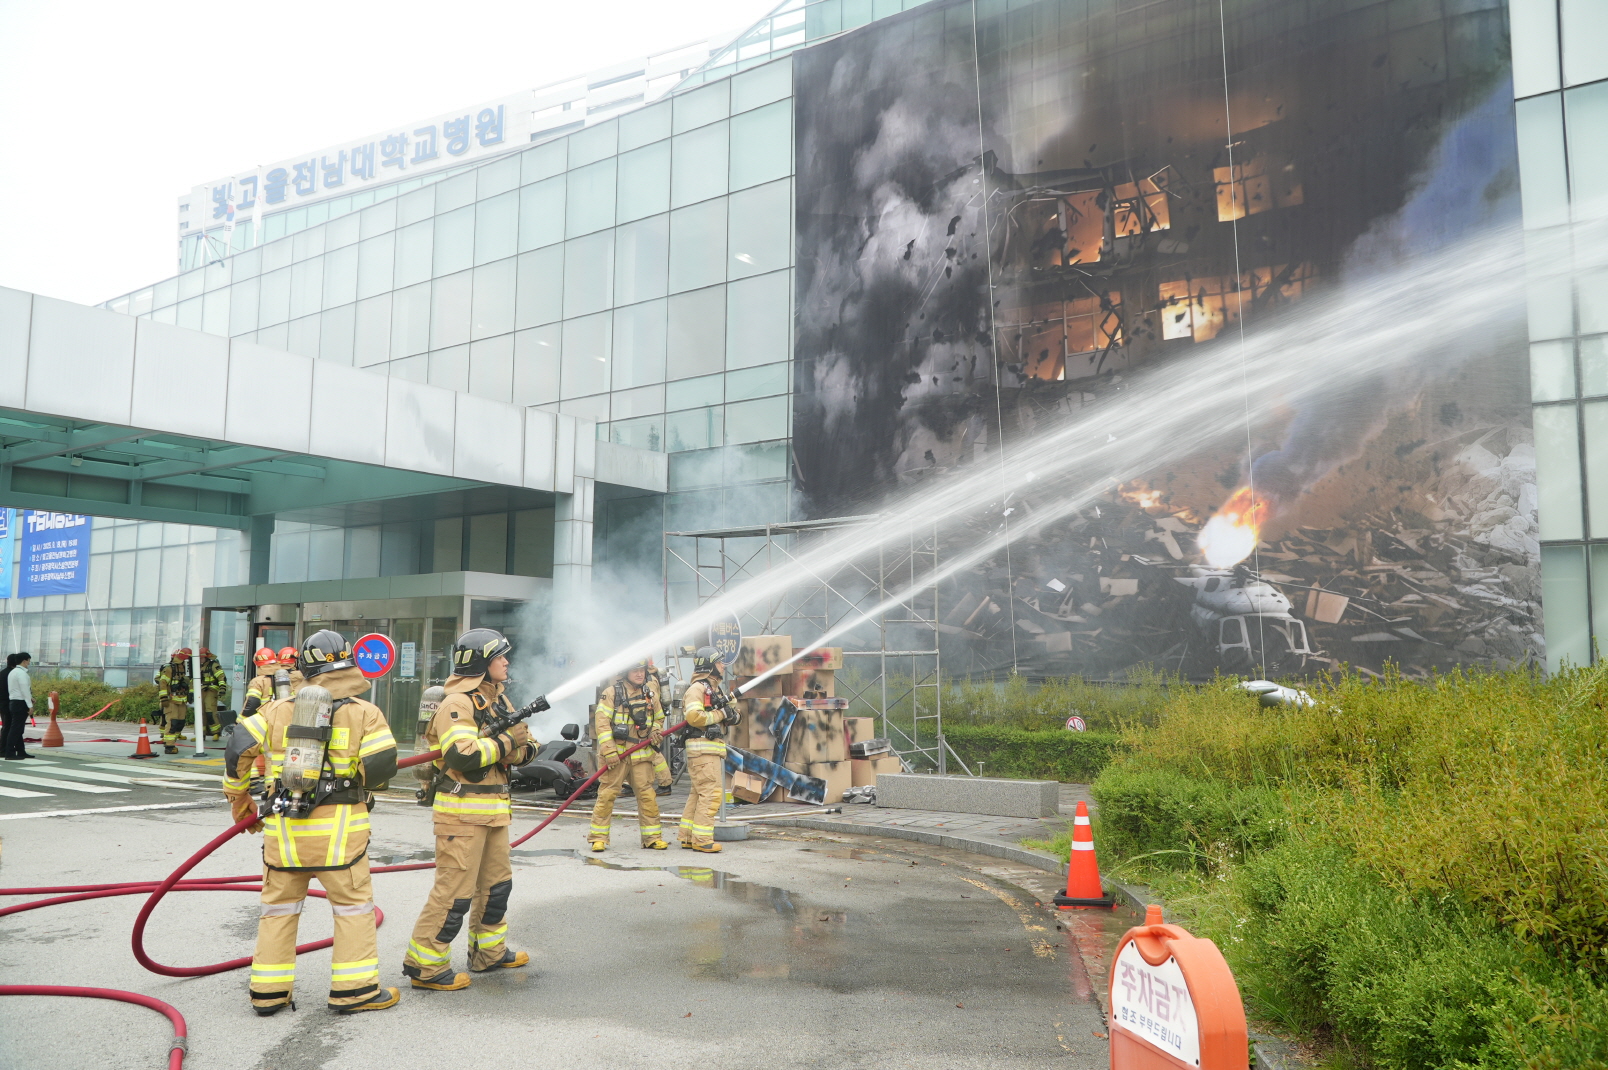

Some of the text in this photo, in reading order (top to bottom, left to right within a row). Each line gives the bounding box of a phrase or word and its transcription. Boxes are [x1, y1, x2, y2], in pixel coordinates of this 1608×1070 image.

[212, 104, 506, 219] 빛고을전남대학교병원
[358, 652, 388, 660] 주차금지
[1139, 1014, 1182, 1050] 부탁드립니다
